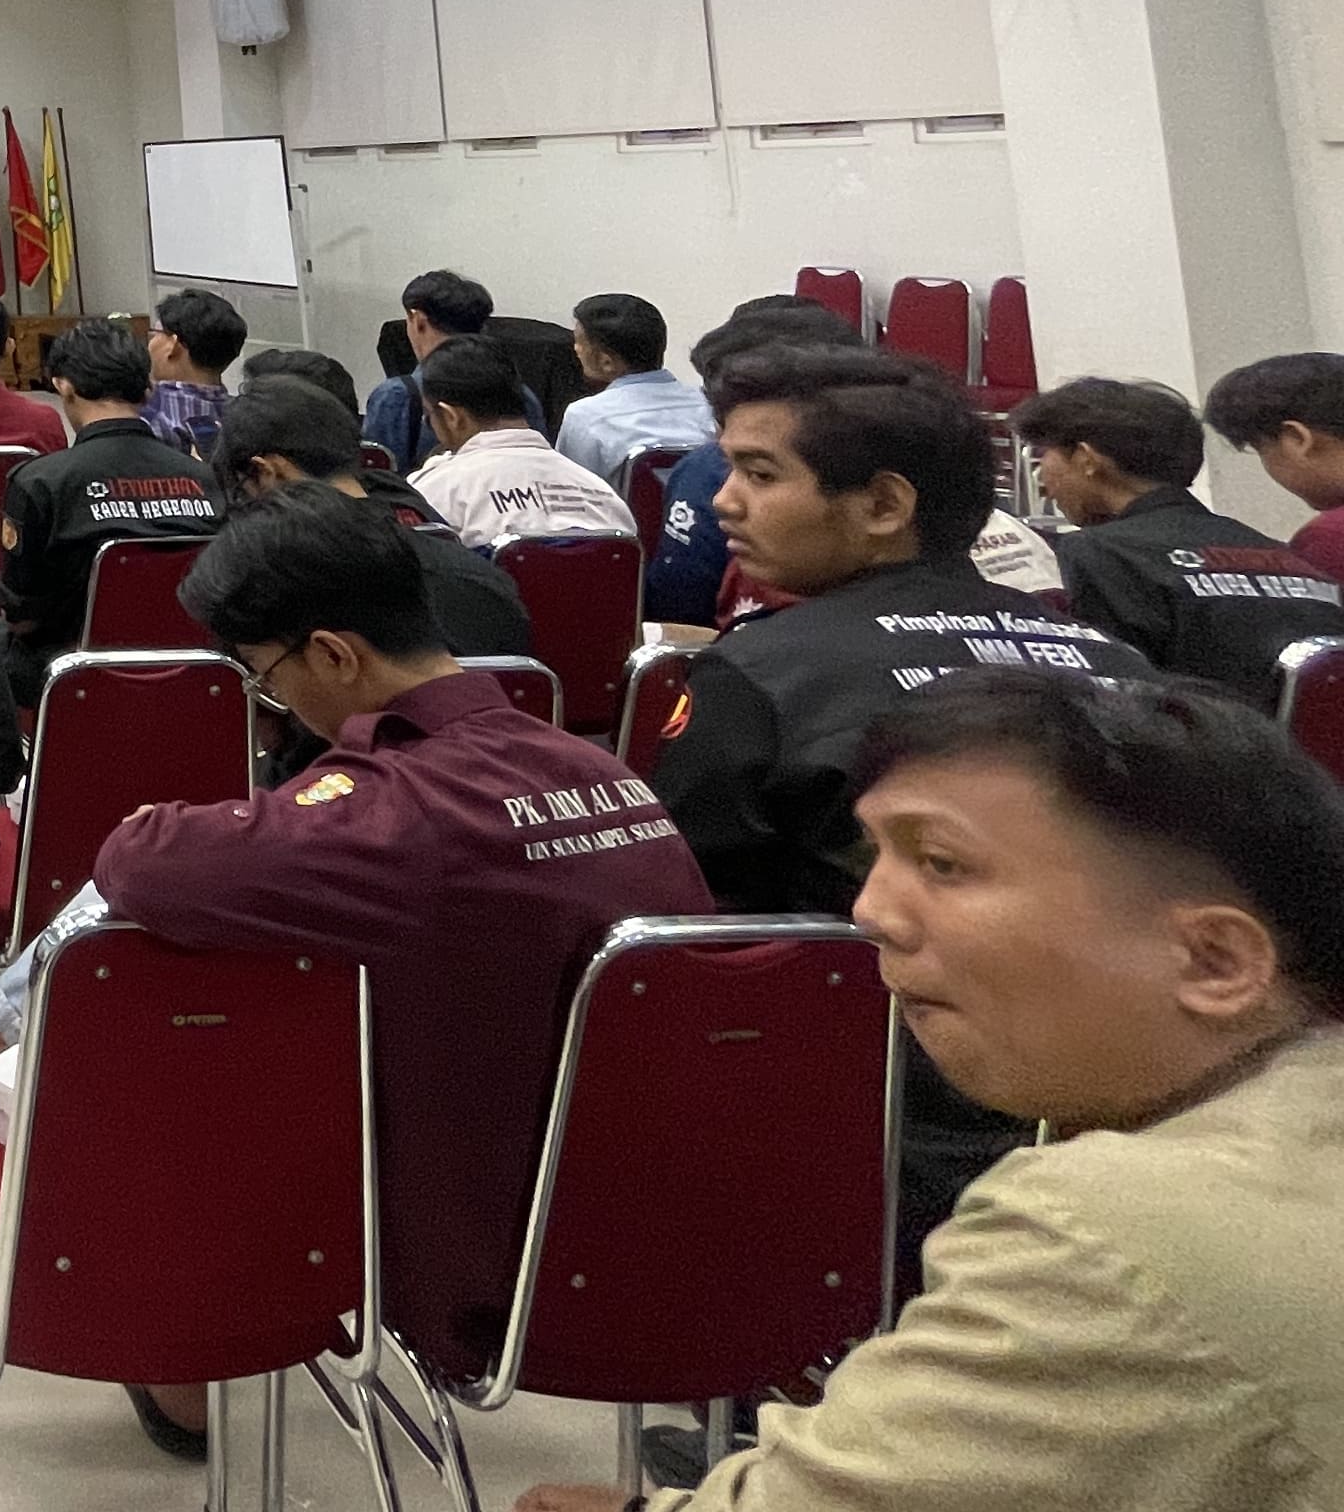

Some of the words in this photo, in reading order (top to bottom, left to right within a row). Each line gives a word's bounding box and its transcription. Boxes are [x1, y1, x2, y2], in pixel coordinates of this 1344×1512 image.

[489, 487, 541, 514] IMM
[875, 611, 996, 635] Pimpinan
[963, 638, 1026, 664] IMM
[1023, 641, 1093, 670] FEBI
[590, 783, 620, 815] AL
